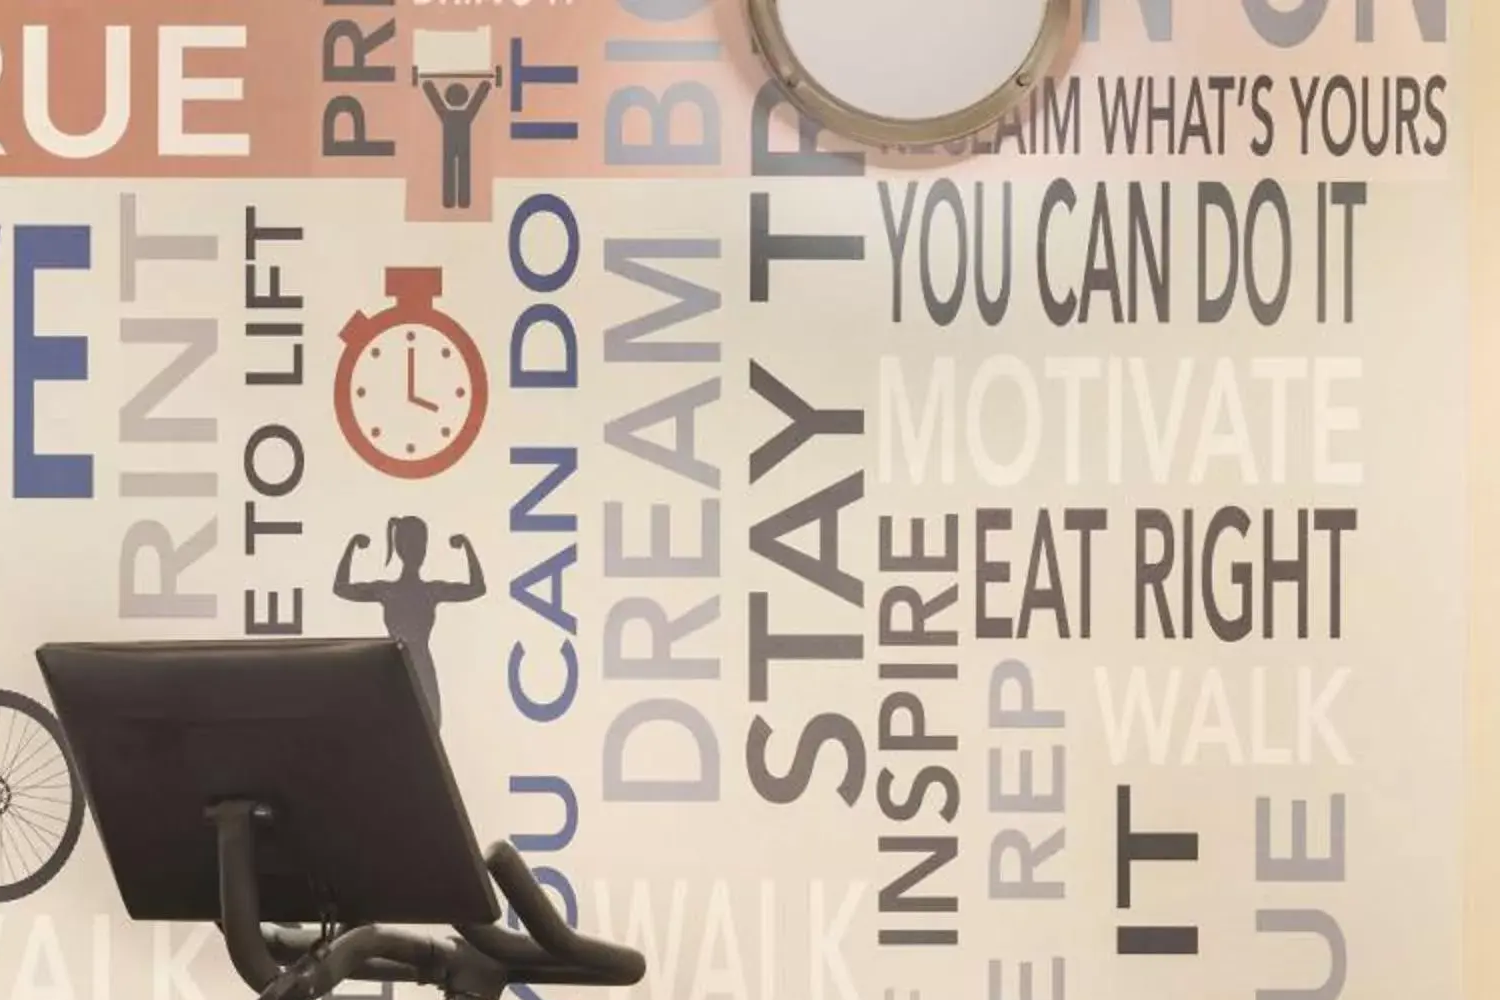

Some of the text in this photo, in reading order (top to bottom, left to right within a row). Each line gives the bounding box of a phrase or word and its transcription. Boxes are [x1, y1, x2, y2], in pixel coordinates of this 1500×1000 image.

[322, 0, 396, 157] PR
[510, 37, 579, 139] IT
[1097, 75, 1274, 157] WHAT'S
[1289, 74, 1448, 157] YOURS
[244, 206, 304, 386] LIFT
[509, 193, 580, 388] DO
[876, 178, 1367, 327] YOU CAN DO IT
[119, 193, 219, 619] RINT
[243, 424, 304, 555] TO
[878, 355, 1364, 486] MOTIVATE
[507, 447, 579, 723] CAN
[603, 237, 721, 802] DREAM
[746, 358, 866, 808] STAY
[975, 506, 1358, 642] EAT RIGHT
[877, 513, 960, 946] INSPIRE
[988, 658, 1066, 899] REP
[1094, 666, 1356, 767] WALK
[1116, 784, 1199, 955] IT
